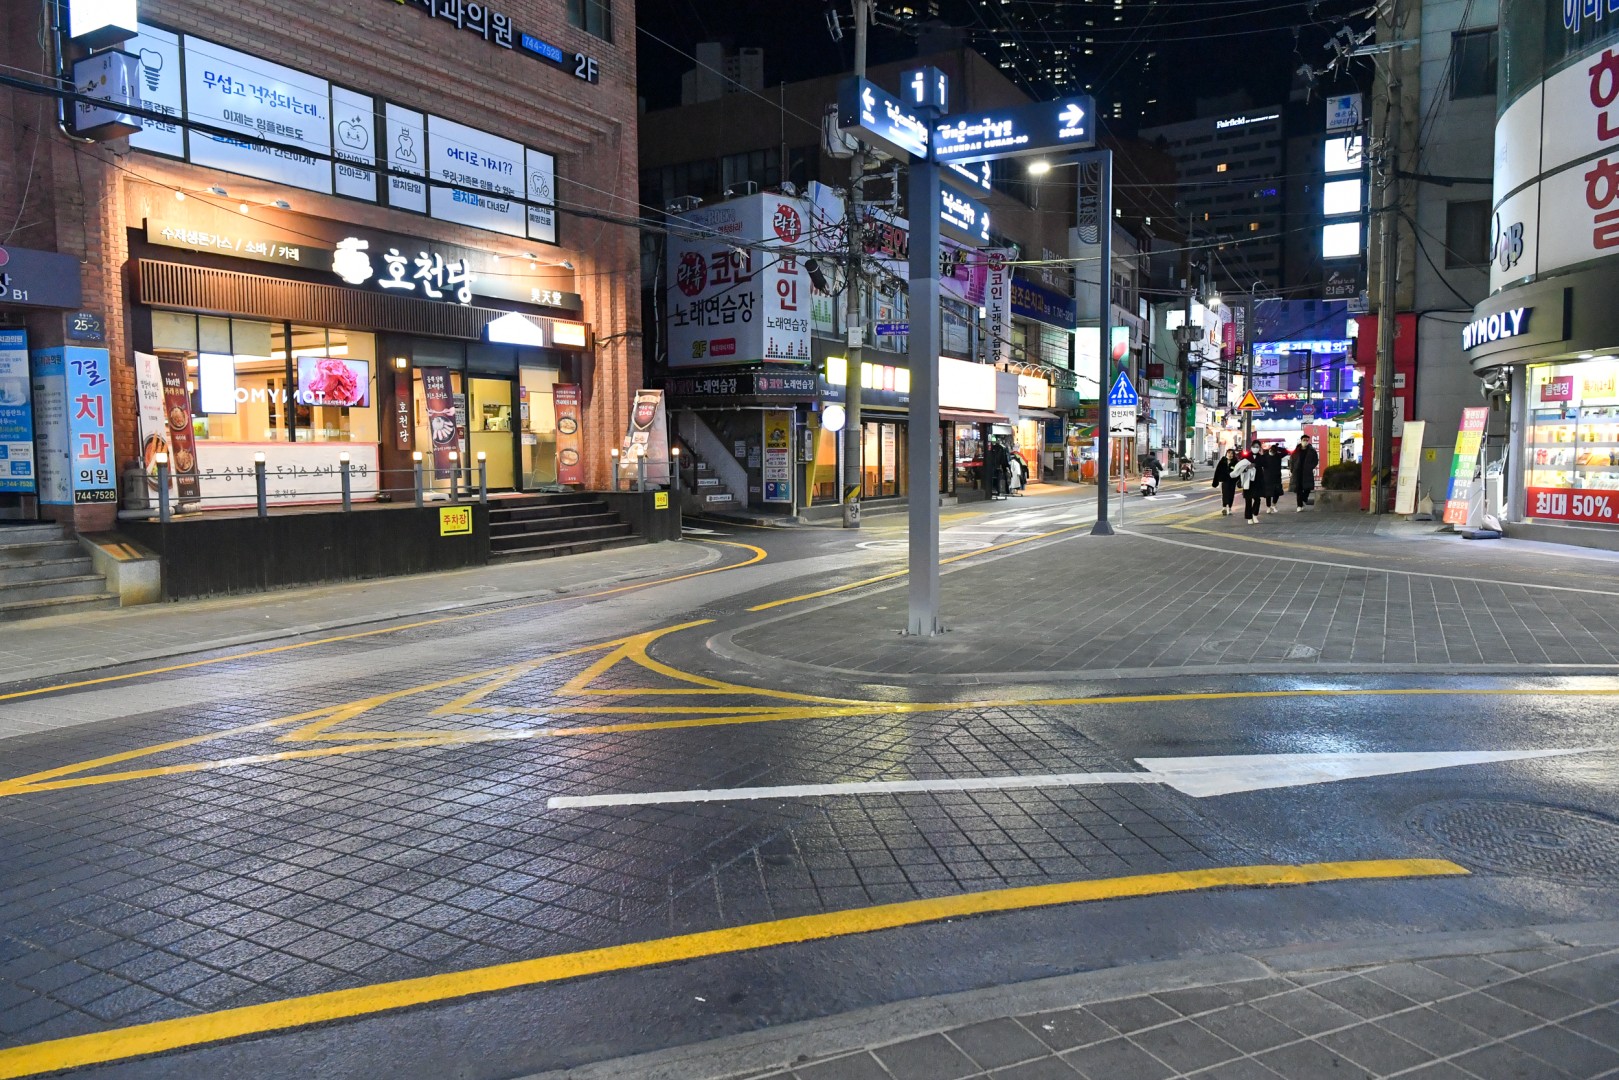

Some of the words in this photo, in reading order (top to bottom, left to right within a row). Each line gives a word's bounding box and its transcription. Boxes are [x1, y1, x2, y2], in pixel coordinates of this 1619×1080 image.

[524, 36, 560, 61] 744-7528
[574, 52, 598, 82] 2F
[203, 71, 246, 96] 무섭고
[248, 83, 325, 120] 걱정되는데..
[223, 109, 253, 127] 이제는
[256, 118, 304, 140] 임플란트도
[1216, 117, 1246, 128] Fairfield
[447, 148, 479, 167] 어디로
[480, 157, 513, 175] 가지??
[339, 165, 371, 182] 안아프게
[442, 169, 457, 181] 우리
[458, 173, 479, 188] 가족은
[245, 241, 267, 256] 소바
[278, 246, 300, 261] 카레
[710, 248, 752, 286] 코인
[379, 247, 478, 306] 호천당
[12, 290, 28, 301] B1
[674, 291, 755, 327] 노래연습장
[74, 319, 100, 331] 25-2
[766, 317, 809, 333] 노래연습장
[691, 340, 707, 358] 2F
[695, 378, 738, 394] 노래연습장
[769, 379, 783, 389] 코인
[783, 378, 814, 390] 노래연습장
[1545, 382, 1569, 396] 클렌징
[398, 402, 409, 443] 호천당
[80, 469, 109, 485] 의원
[339, 464, 367, 478] 문점
[76, 491, 115, 501] 744-7528
[1454, 488, 1467, 499] 1+1
[1536, 491, 1567, 515] 최대
[1572, 495, 1612, 518] 50%
[443, 513, 466, 525] 주차장
[1450, 509, 1463, 520] 1+1
